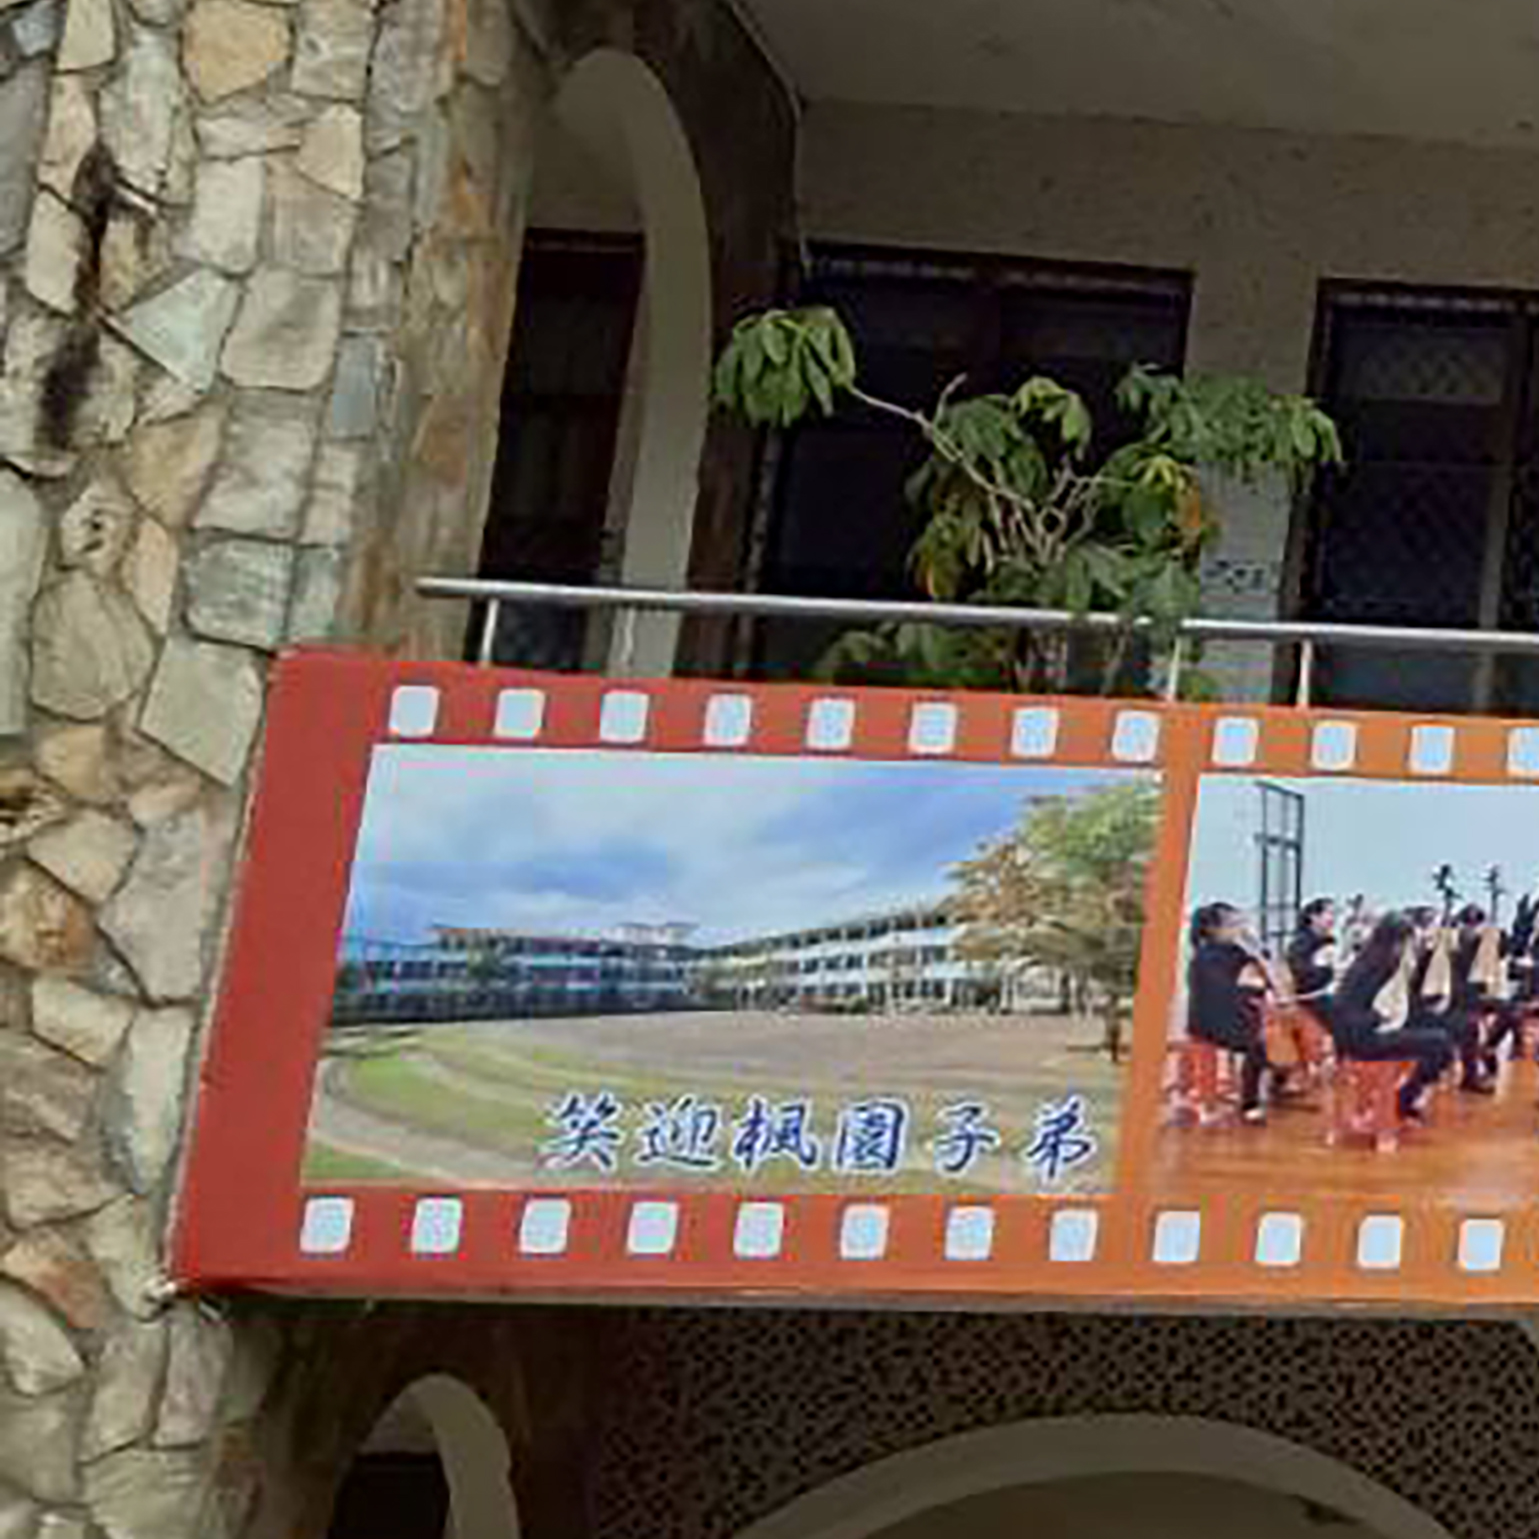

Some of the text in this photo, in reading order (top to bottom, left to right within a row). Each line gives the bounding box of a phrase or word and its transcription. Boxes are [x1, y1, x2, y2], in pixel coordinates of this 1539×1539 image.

[542, 1093, 1100, 1183] 笑迎楓園子弟
